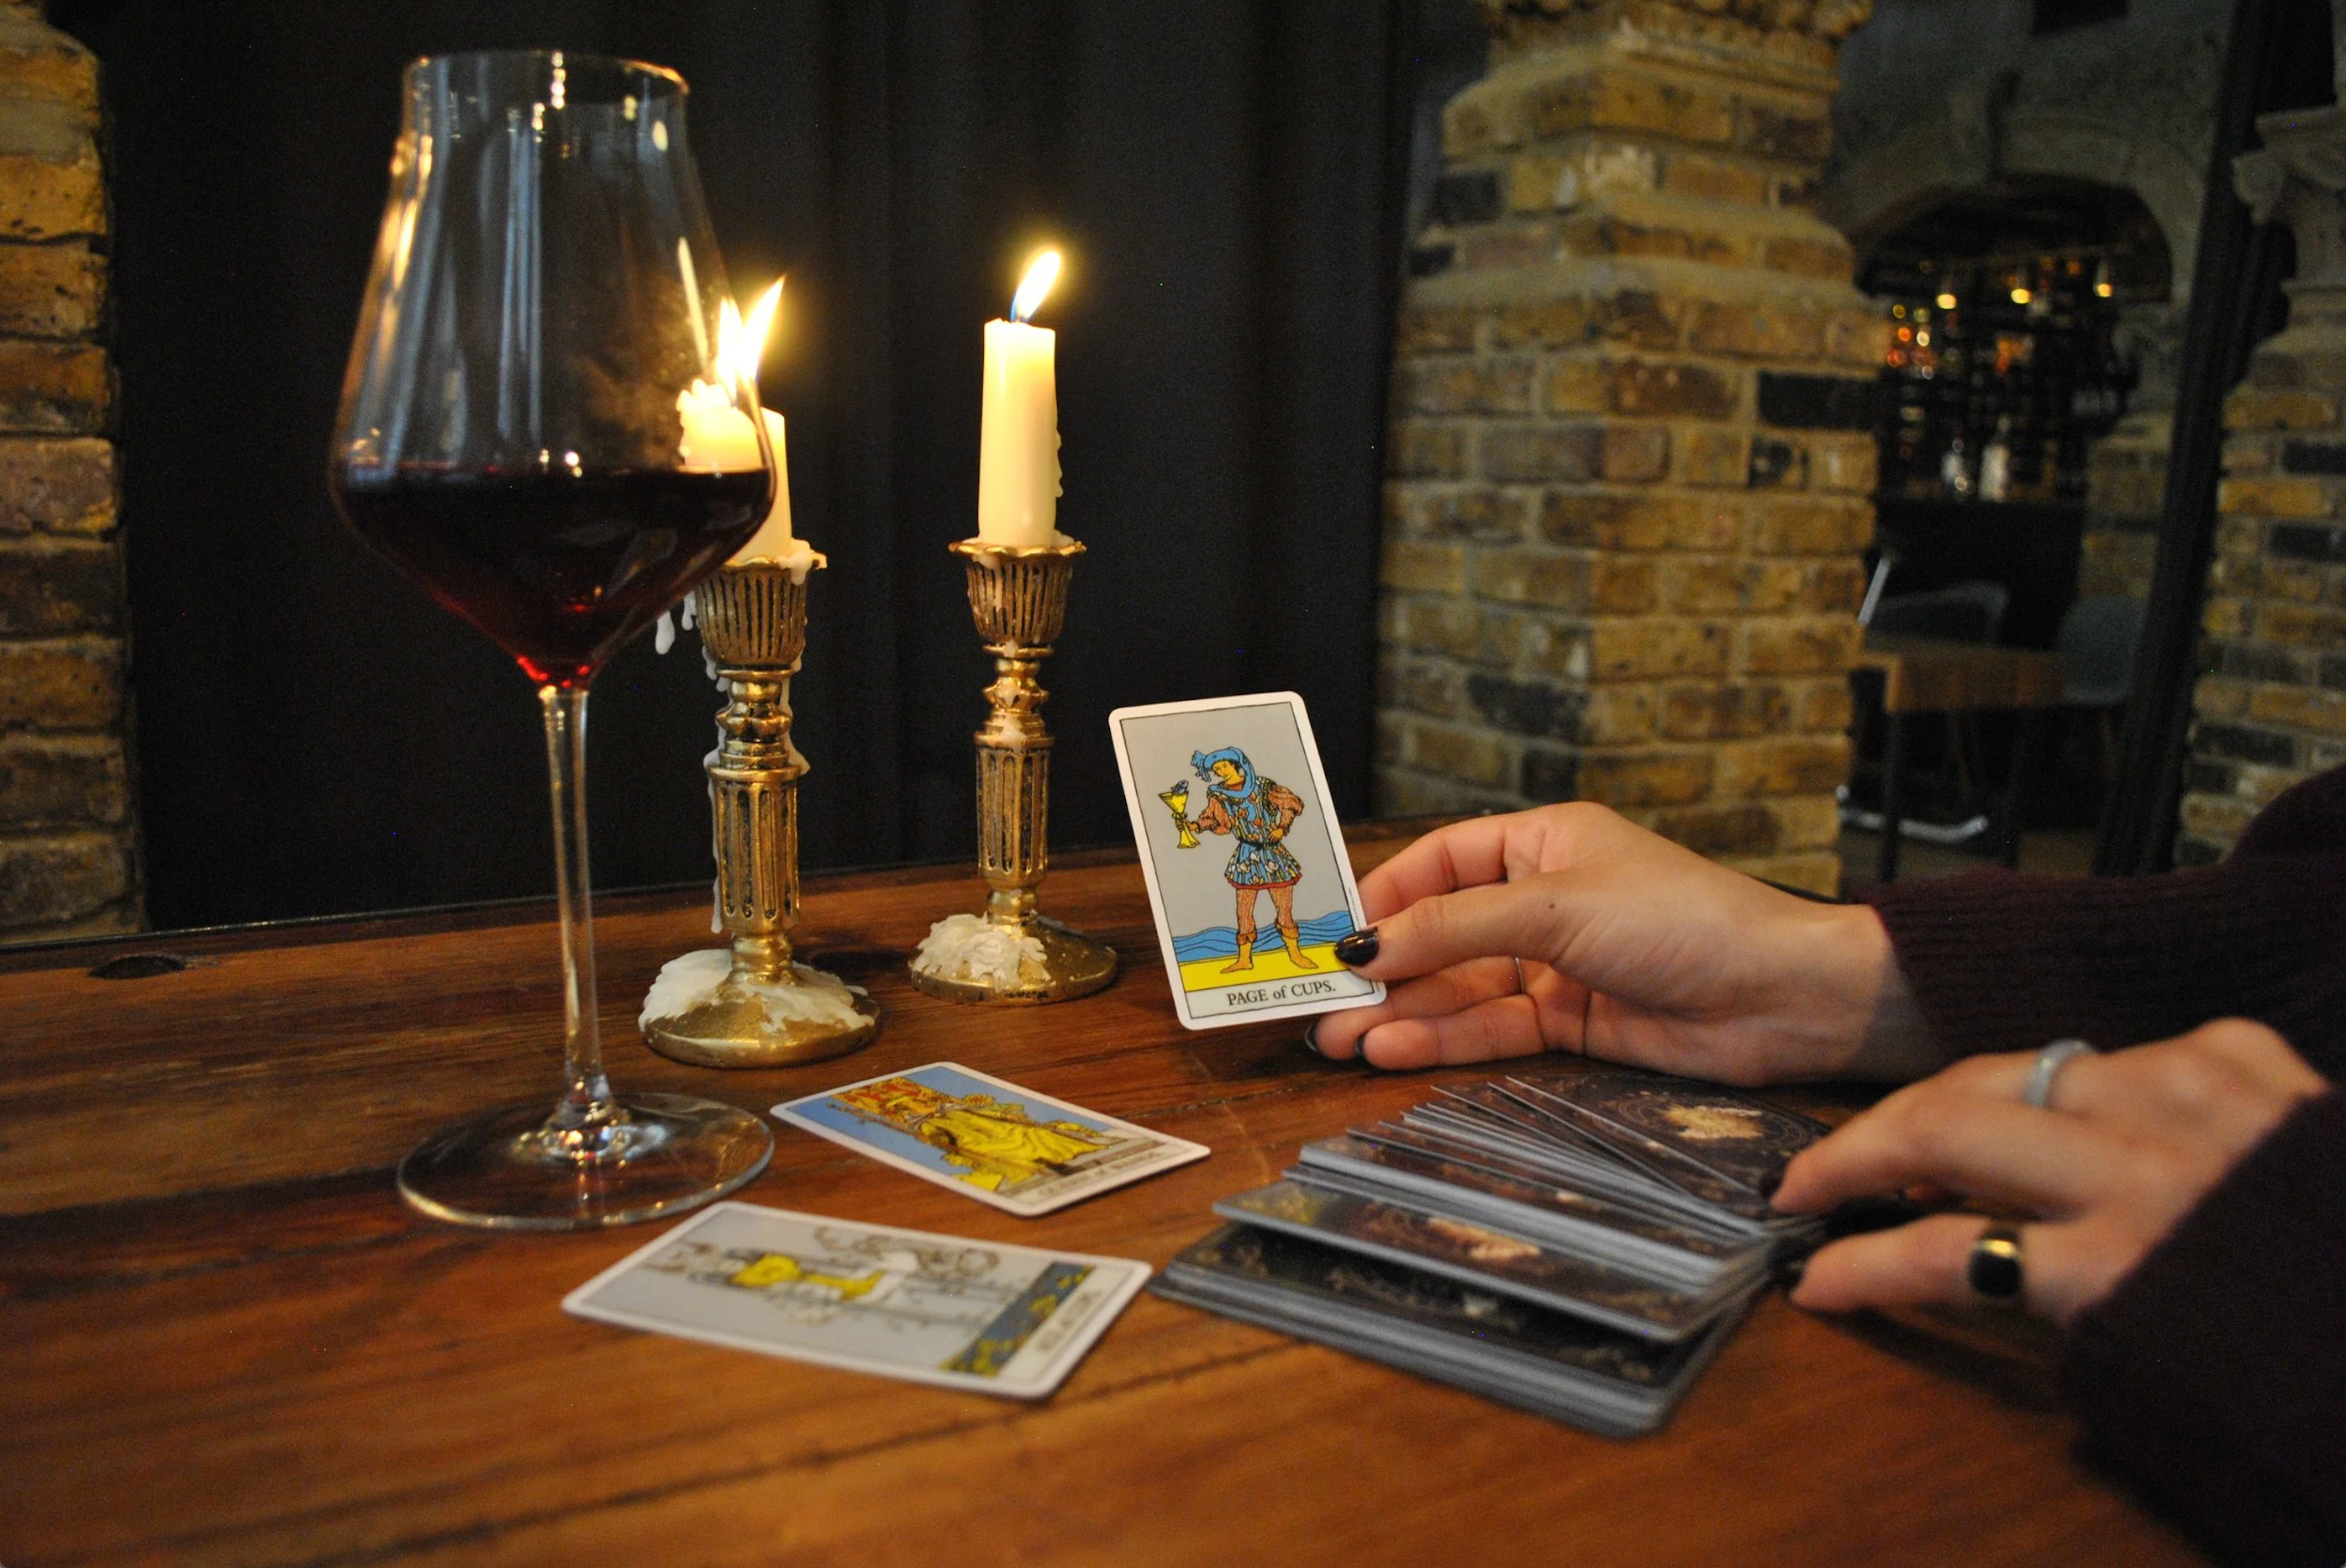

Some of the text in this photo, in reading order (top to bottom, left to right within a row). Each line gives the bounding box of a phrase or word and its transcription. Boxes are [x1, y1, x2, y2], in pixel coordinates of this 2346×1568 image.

[1227, 980, 1336, 1006] PAGE of CUPS.
